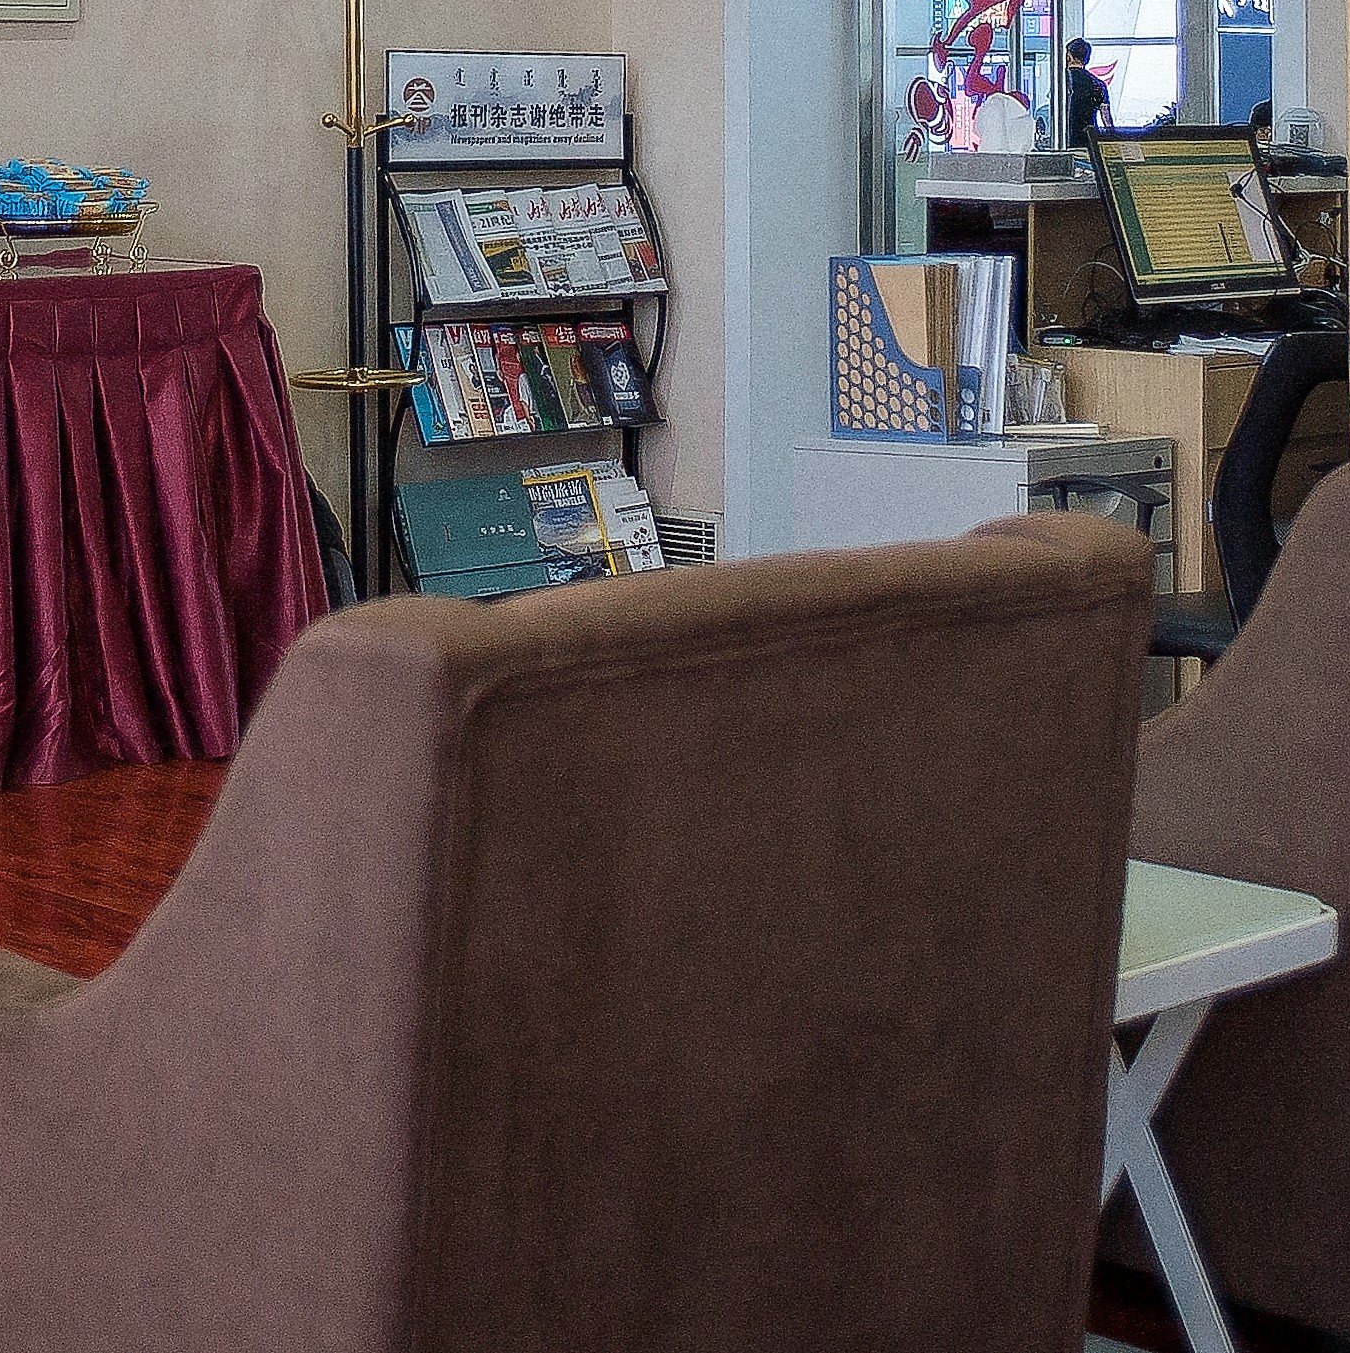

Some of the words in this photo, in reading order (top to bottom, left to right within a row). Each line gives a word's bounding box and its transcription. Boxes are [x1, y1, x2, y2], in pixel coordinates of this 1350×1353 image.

[451, 103, 605, 129] 报刊杂志谢绝带走
[451, 134, 496, 146] Newspapers
[497, 135, 512, 144] and
[512, 135, 552, 146] magazines
[553, 136, 573, 146] away
[573, 133, 605, 144] declined
